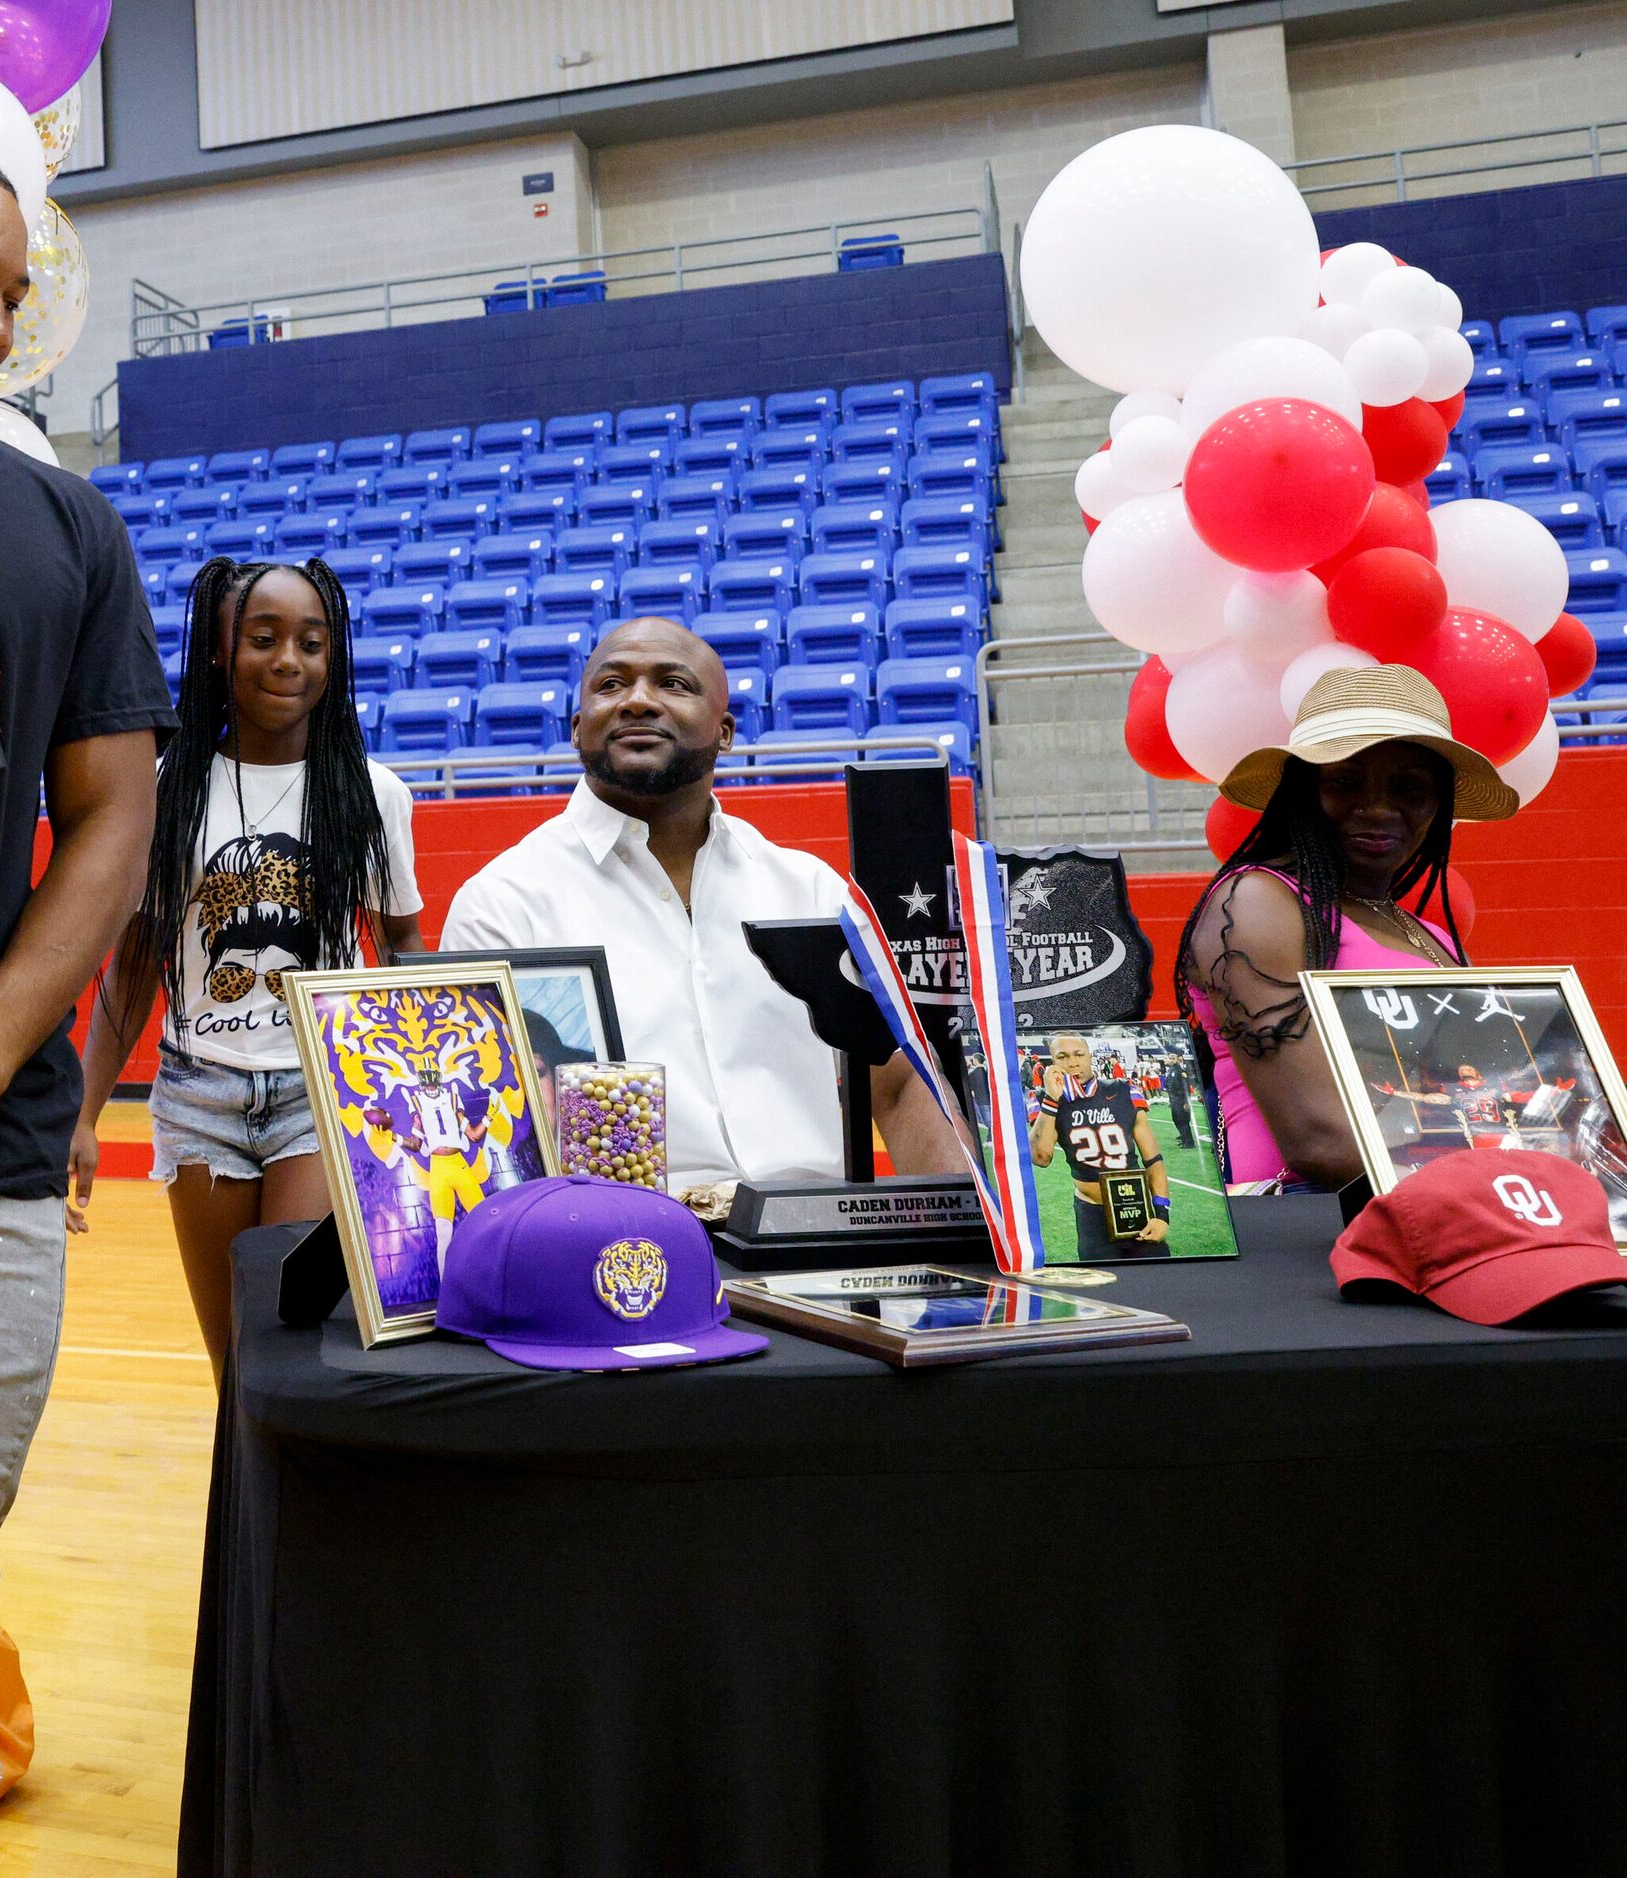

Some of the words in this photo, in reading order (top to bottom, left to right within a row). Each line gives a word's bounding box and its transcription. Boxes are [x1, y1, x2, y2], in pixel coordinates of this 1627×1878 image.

[1023, 930, 1094, 947] FOOTBALL
[1013, 945, 1095, 984] YEAR
[1460, 1097, 1500, 1123] 29
[1068, 1123, 1130, 1170] 29
[837, 1199, 891, 1214] CADEN
[894, 1196, 962, 1211] DURHAM
[849, 1214, 922, 1226] DUNCANVILLE
[923, 1213, 948, 1222] HIGH
[1119, 1209, 1142, 1220] MVP
